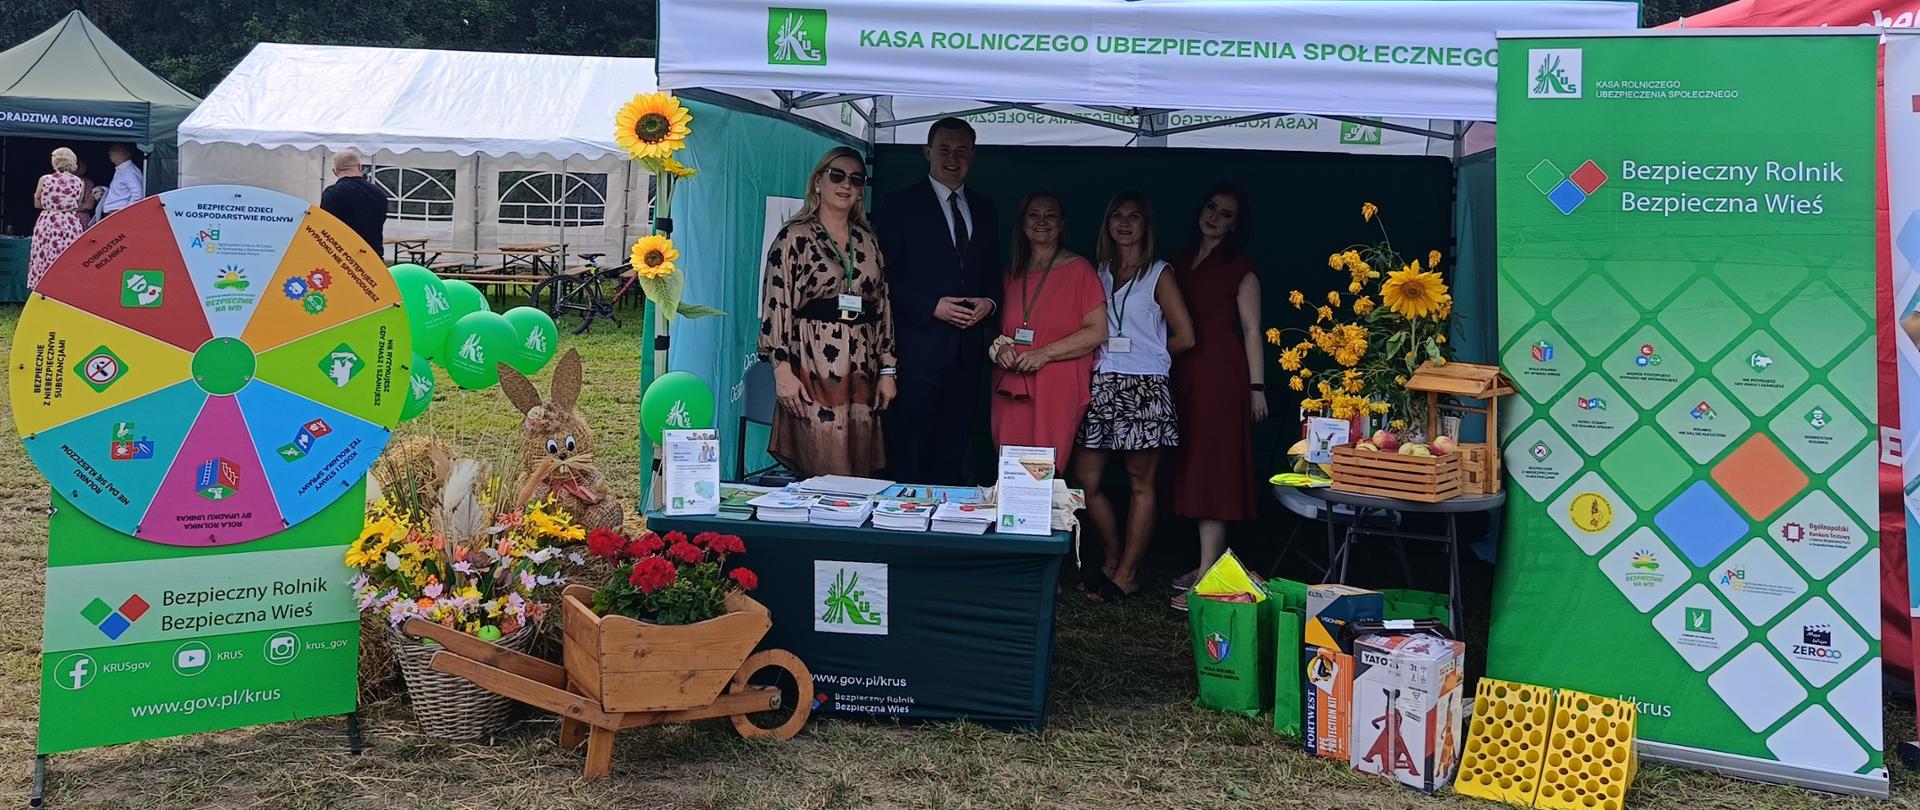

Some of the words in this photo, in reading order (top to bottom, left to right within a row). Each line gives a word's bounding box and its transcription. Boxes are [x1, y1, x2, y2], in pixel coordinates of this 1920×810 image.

[860, 29, 924, 49] KASA
[931, 32, 1089, 55] ROLNICZEGO
[1096, 35, 1296, 60] UBEZPIECZENIA
[1596, 81, 1620, 89] KASA
[1621, 81, 1680, 89] ROLNICZEGO
[1596, 90, 1666, 98] UBEZPIECZENIA
[1668, 90, 1738, 98] SPOŁECZNEGO
[62, 115, 133, 127] ROLNICZEGO
[1622, 160, 1758, 186] Bezpieczny
[1766, 160, 1844, 182] Rolnik
[185, 211, 259, 222] GOSPODARSTWIE
[260, 215, 294, 223] ROLNYM
[197, 203, 246, 213] BEZPIECZNE
[247, 206, 273, 214] DZIECI
[1621, 191, 1757, 217] Bezpieczna
[1764, 193, 1824, 215] Wieś
[82, 232, 126, 268] DOBROSTAN
[95, 245, 127, 270] ROLNIKA
[305, 225, 334, 255] WYPADKU
[331, 252, 343, 265] NIE
[340, 262, 380, 303] SPOWODUJESZ
[33, 344, 44, 394] BEZPIECZNIE
[43, 331, 56, 400] NIEBEZPIECZNYMI
[54, 339, 66, 399] SUBSTANCJAMI
[60, 443, 98, 478] KLESZCZOM
[323, 447, 351, 472] ROLNIKA
[73, 469, 103, 495] ROLNIKU
[104, 482, 120, 497] DAJ
[298, 470, 325, 497] SPRAWY
[314, 471, 337, 492] STAWY
[117, 493, 130, 506] NIE
[183, 522, 219, 530] ROLNIKA
[207, 513, 240, 521] UPADKU
[1809, 523, 1849, 532] Ogólnopolski
[163, 583, 267, 607] Bezpieczny
[273, 577, 328, 597] Rolnik
[162, 608, 266, 631] Bezpieczna
[271, 602, 313, 620] Wieś
[103, 660, 151, 674] KRUSgov
[217, 650, 243, 661] KRUS
[305, 637, 349, 651] krus_gov
[1364, 653, 1388, 666] YATO
[131, 687, 282, 718] www.gov.pl/krus
[835, 702, 886, 713] Bezpieczna
[887, 704, 910, 714] Wieś
[1307, 689, 1316, 749] PORTWEST
[1327, 708, 1337, 753] PROTECTION
[1319, 735, 1328, 751] PPE
